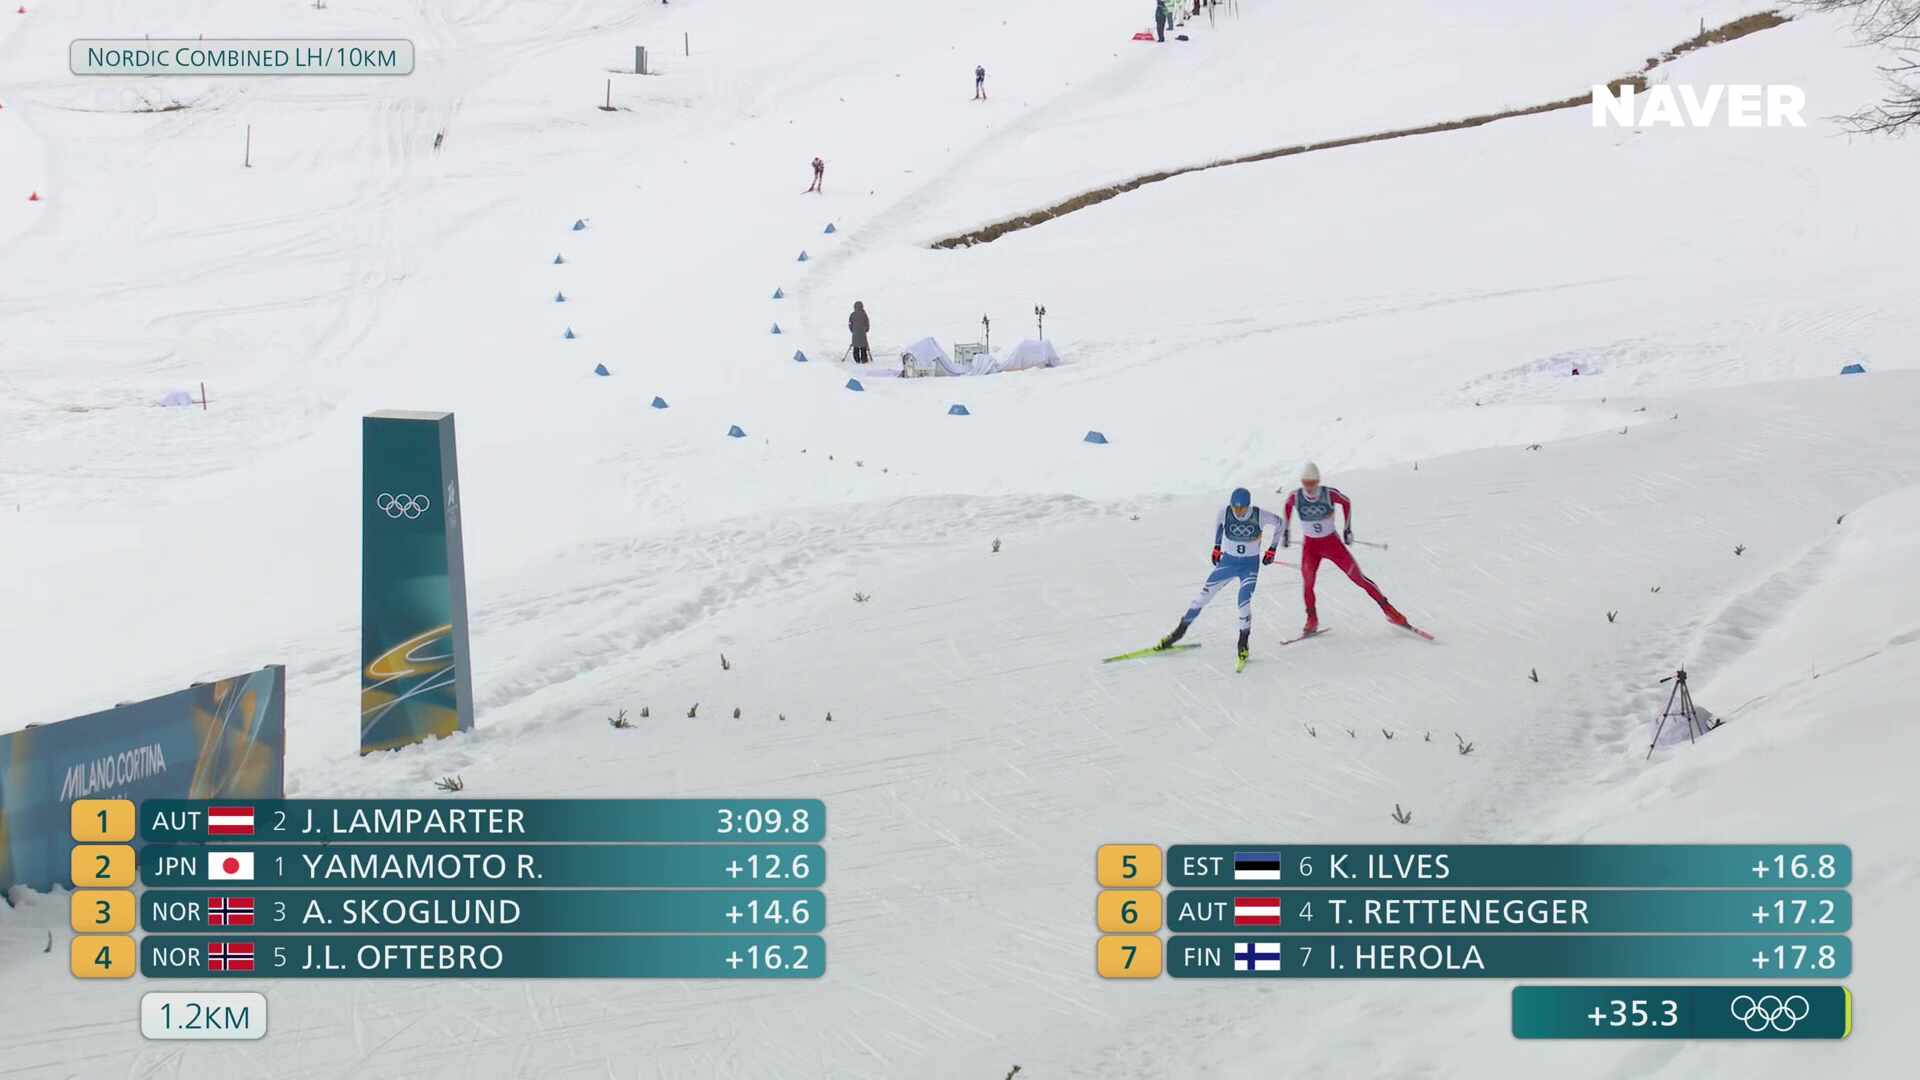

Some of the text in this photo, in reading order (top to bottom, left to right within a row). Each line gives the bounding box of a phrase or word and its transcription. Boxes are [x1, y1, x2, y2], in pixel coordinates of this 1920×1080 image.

[1312, 523, 1323, 534] 9
[1236, 544, 1247, 555] 8
[60, 744, 166, 801] MILANO CORTINA
